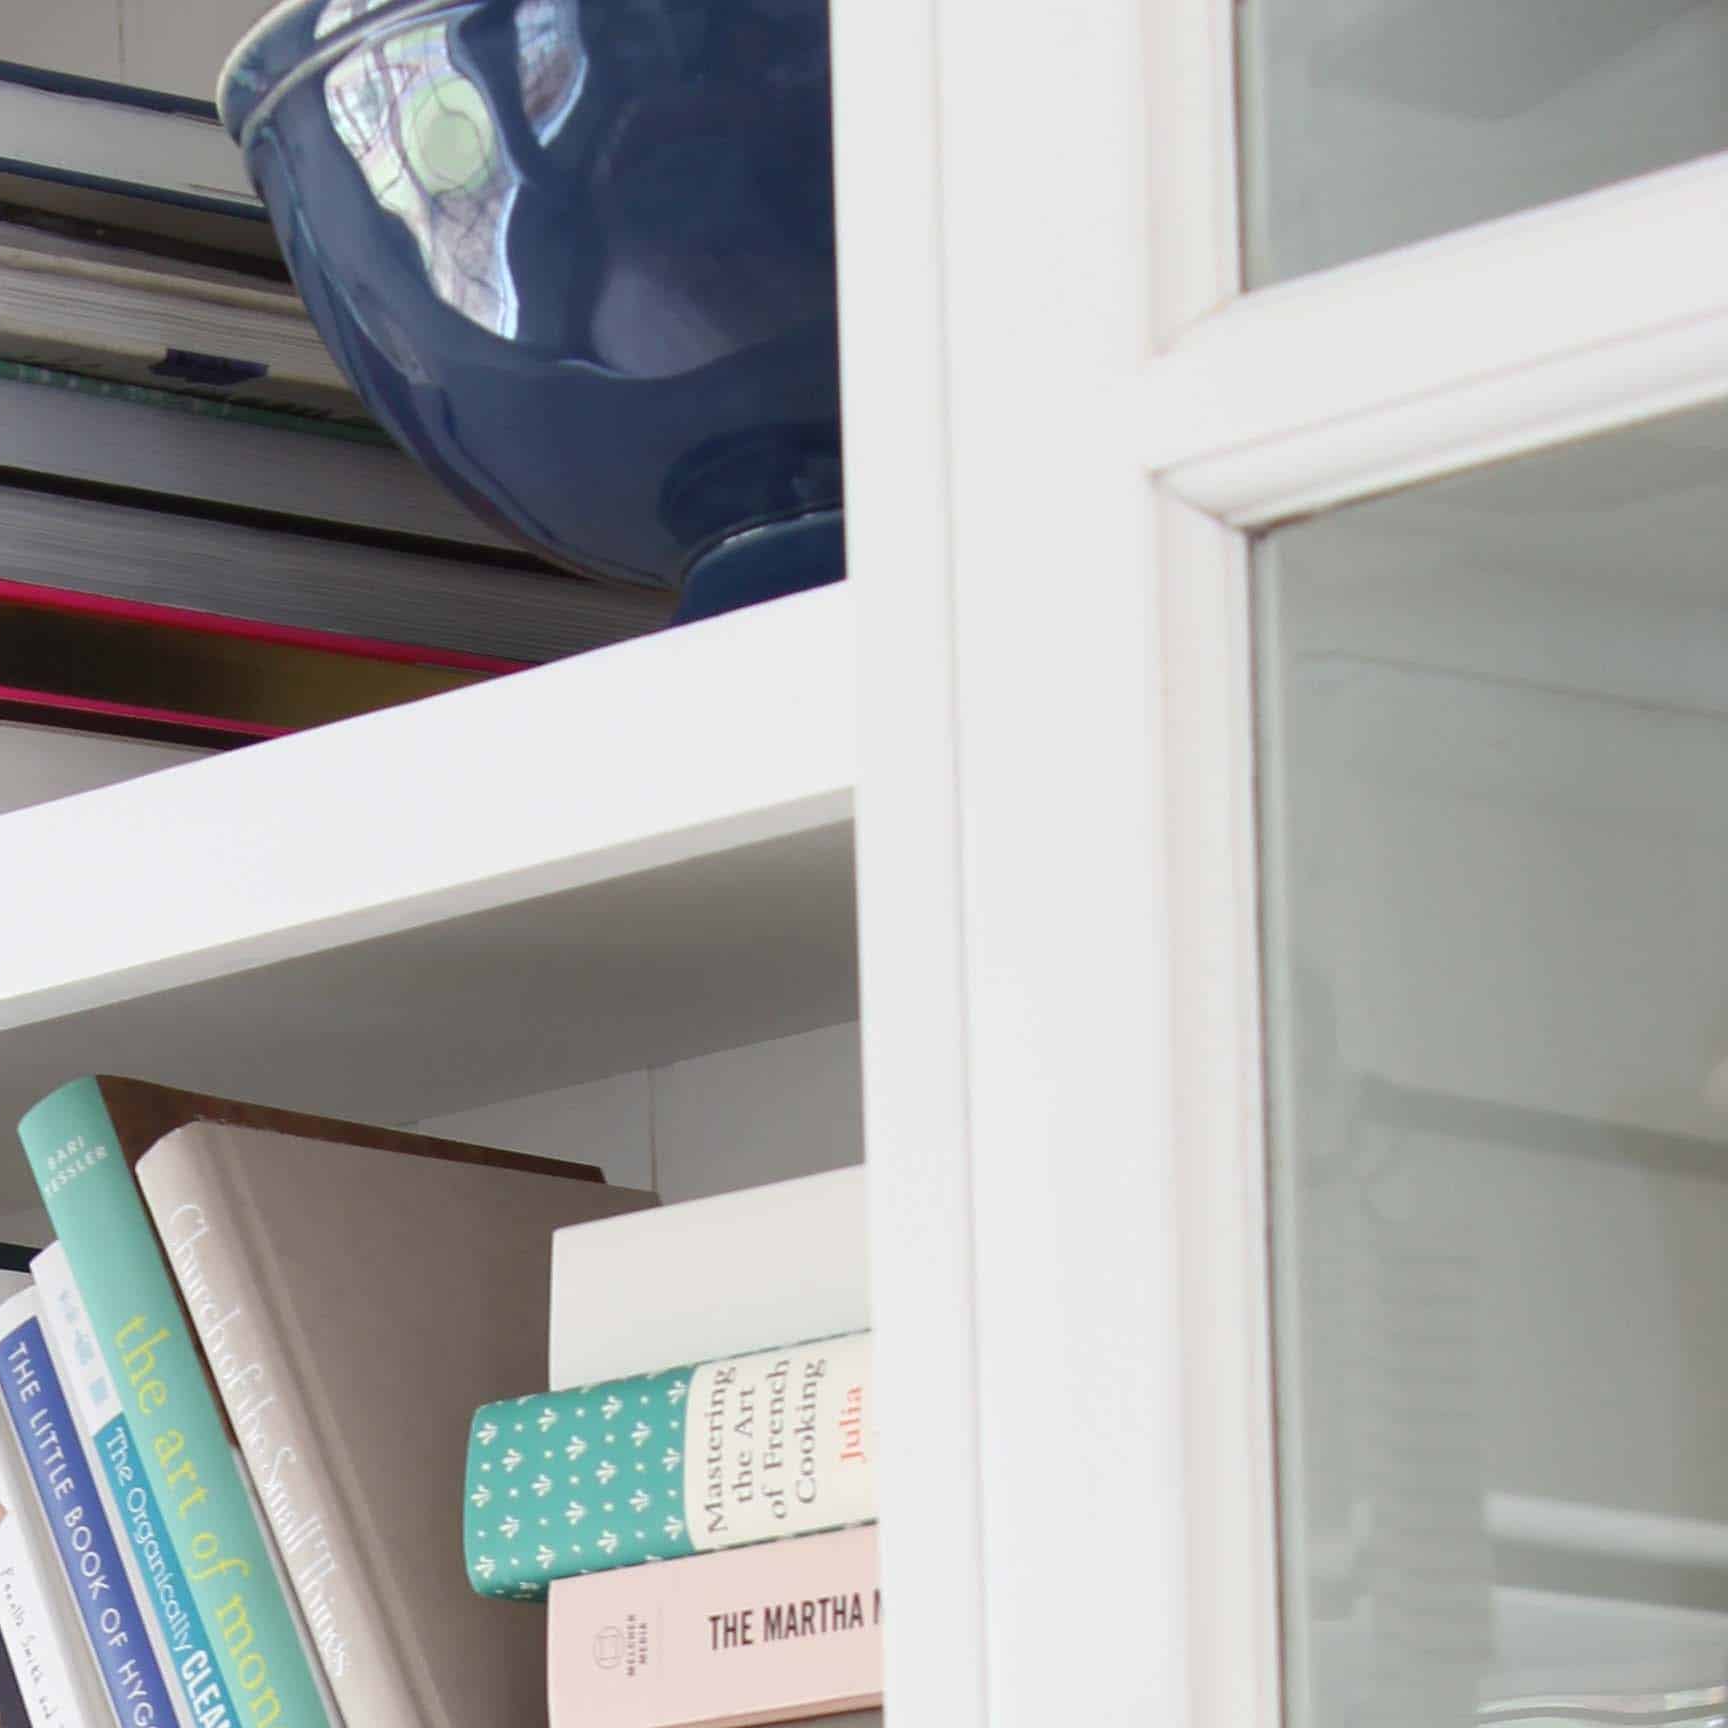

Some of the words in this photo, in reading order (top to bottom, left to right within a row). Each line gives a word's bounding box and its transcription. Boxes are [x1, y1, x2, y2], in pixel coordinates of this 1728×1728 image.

[114, 1312, 169, 1415] the
[154, 1427, 209, 1520] art
[191, 1531, 249, 1581] of
[704, 1366, 737, 1534] Mastering
[734, 1386, 756, 1440] Art
[762, 1359, 790, 1470] French
[794, 1358, 827, 1505] Cooking
[839, 1386, 867, 1465] Julia
[8, 1342, 41, 1403] THE
[29, 1408, 75, 1502] LITTLE
[63, 1506, 111, 1601] BOOK
[100, 1606, 129, 1650] OF
[734, 1454, 753, 1505] the
[764, 1483, 786, 1521] of
[106, 1426, 135, 1487] The
[125, 1487, 196, 1652] Organically
[709, 1610, 754, 1652] THE
[763, 1594, 863, 1641] MARTHA
